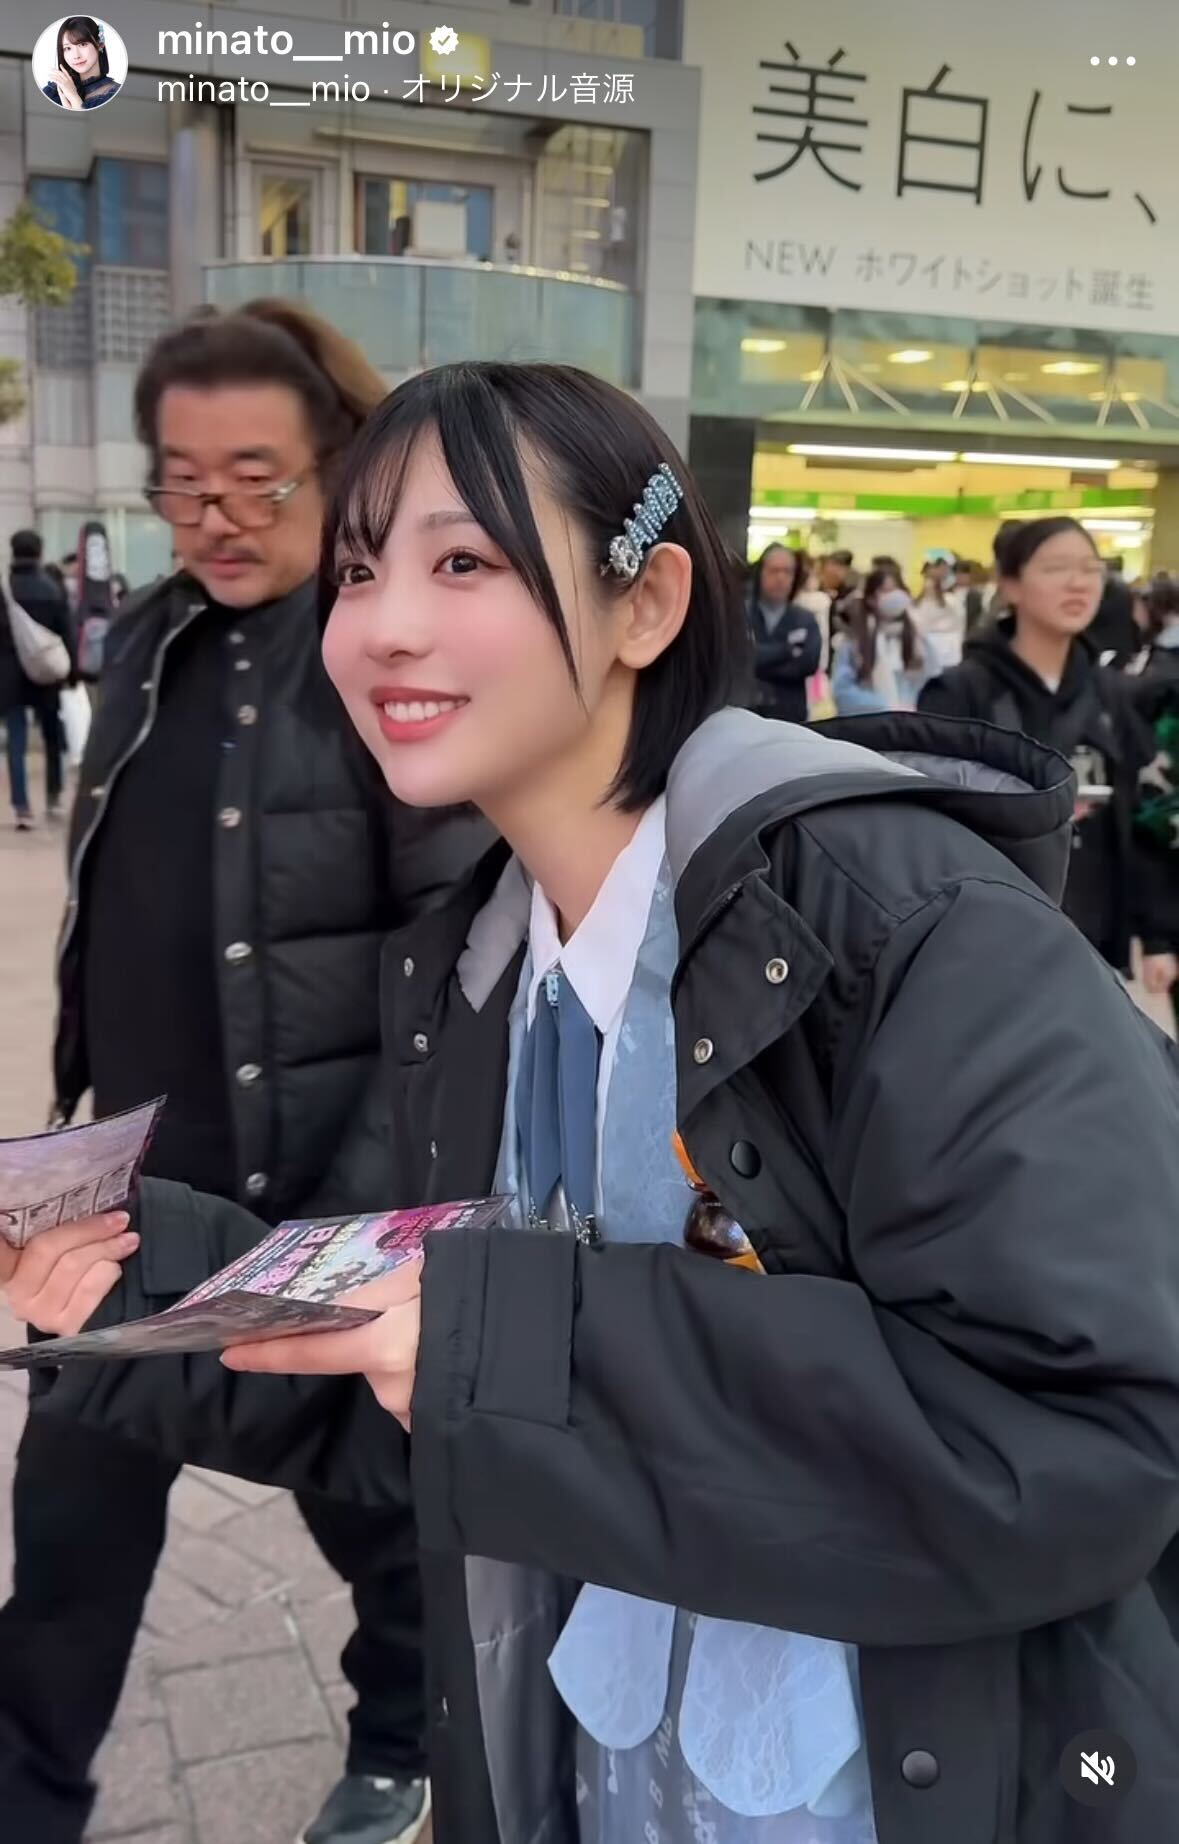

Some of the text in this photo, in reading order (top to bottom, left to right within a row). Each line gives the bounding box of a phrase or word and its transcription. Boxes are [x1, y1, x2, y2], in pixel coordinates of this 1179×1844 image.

[752, 41, 1156, 224] 美白に、
[745, 240, 1155, 311] NEW ホワイトショット誕生
